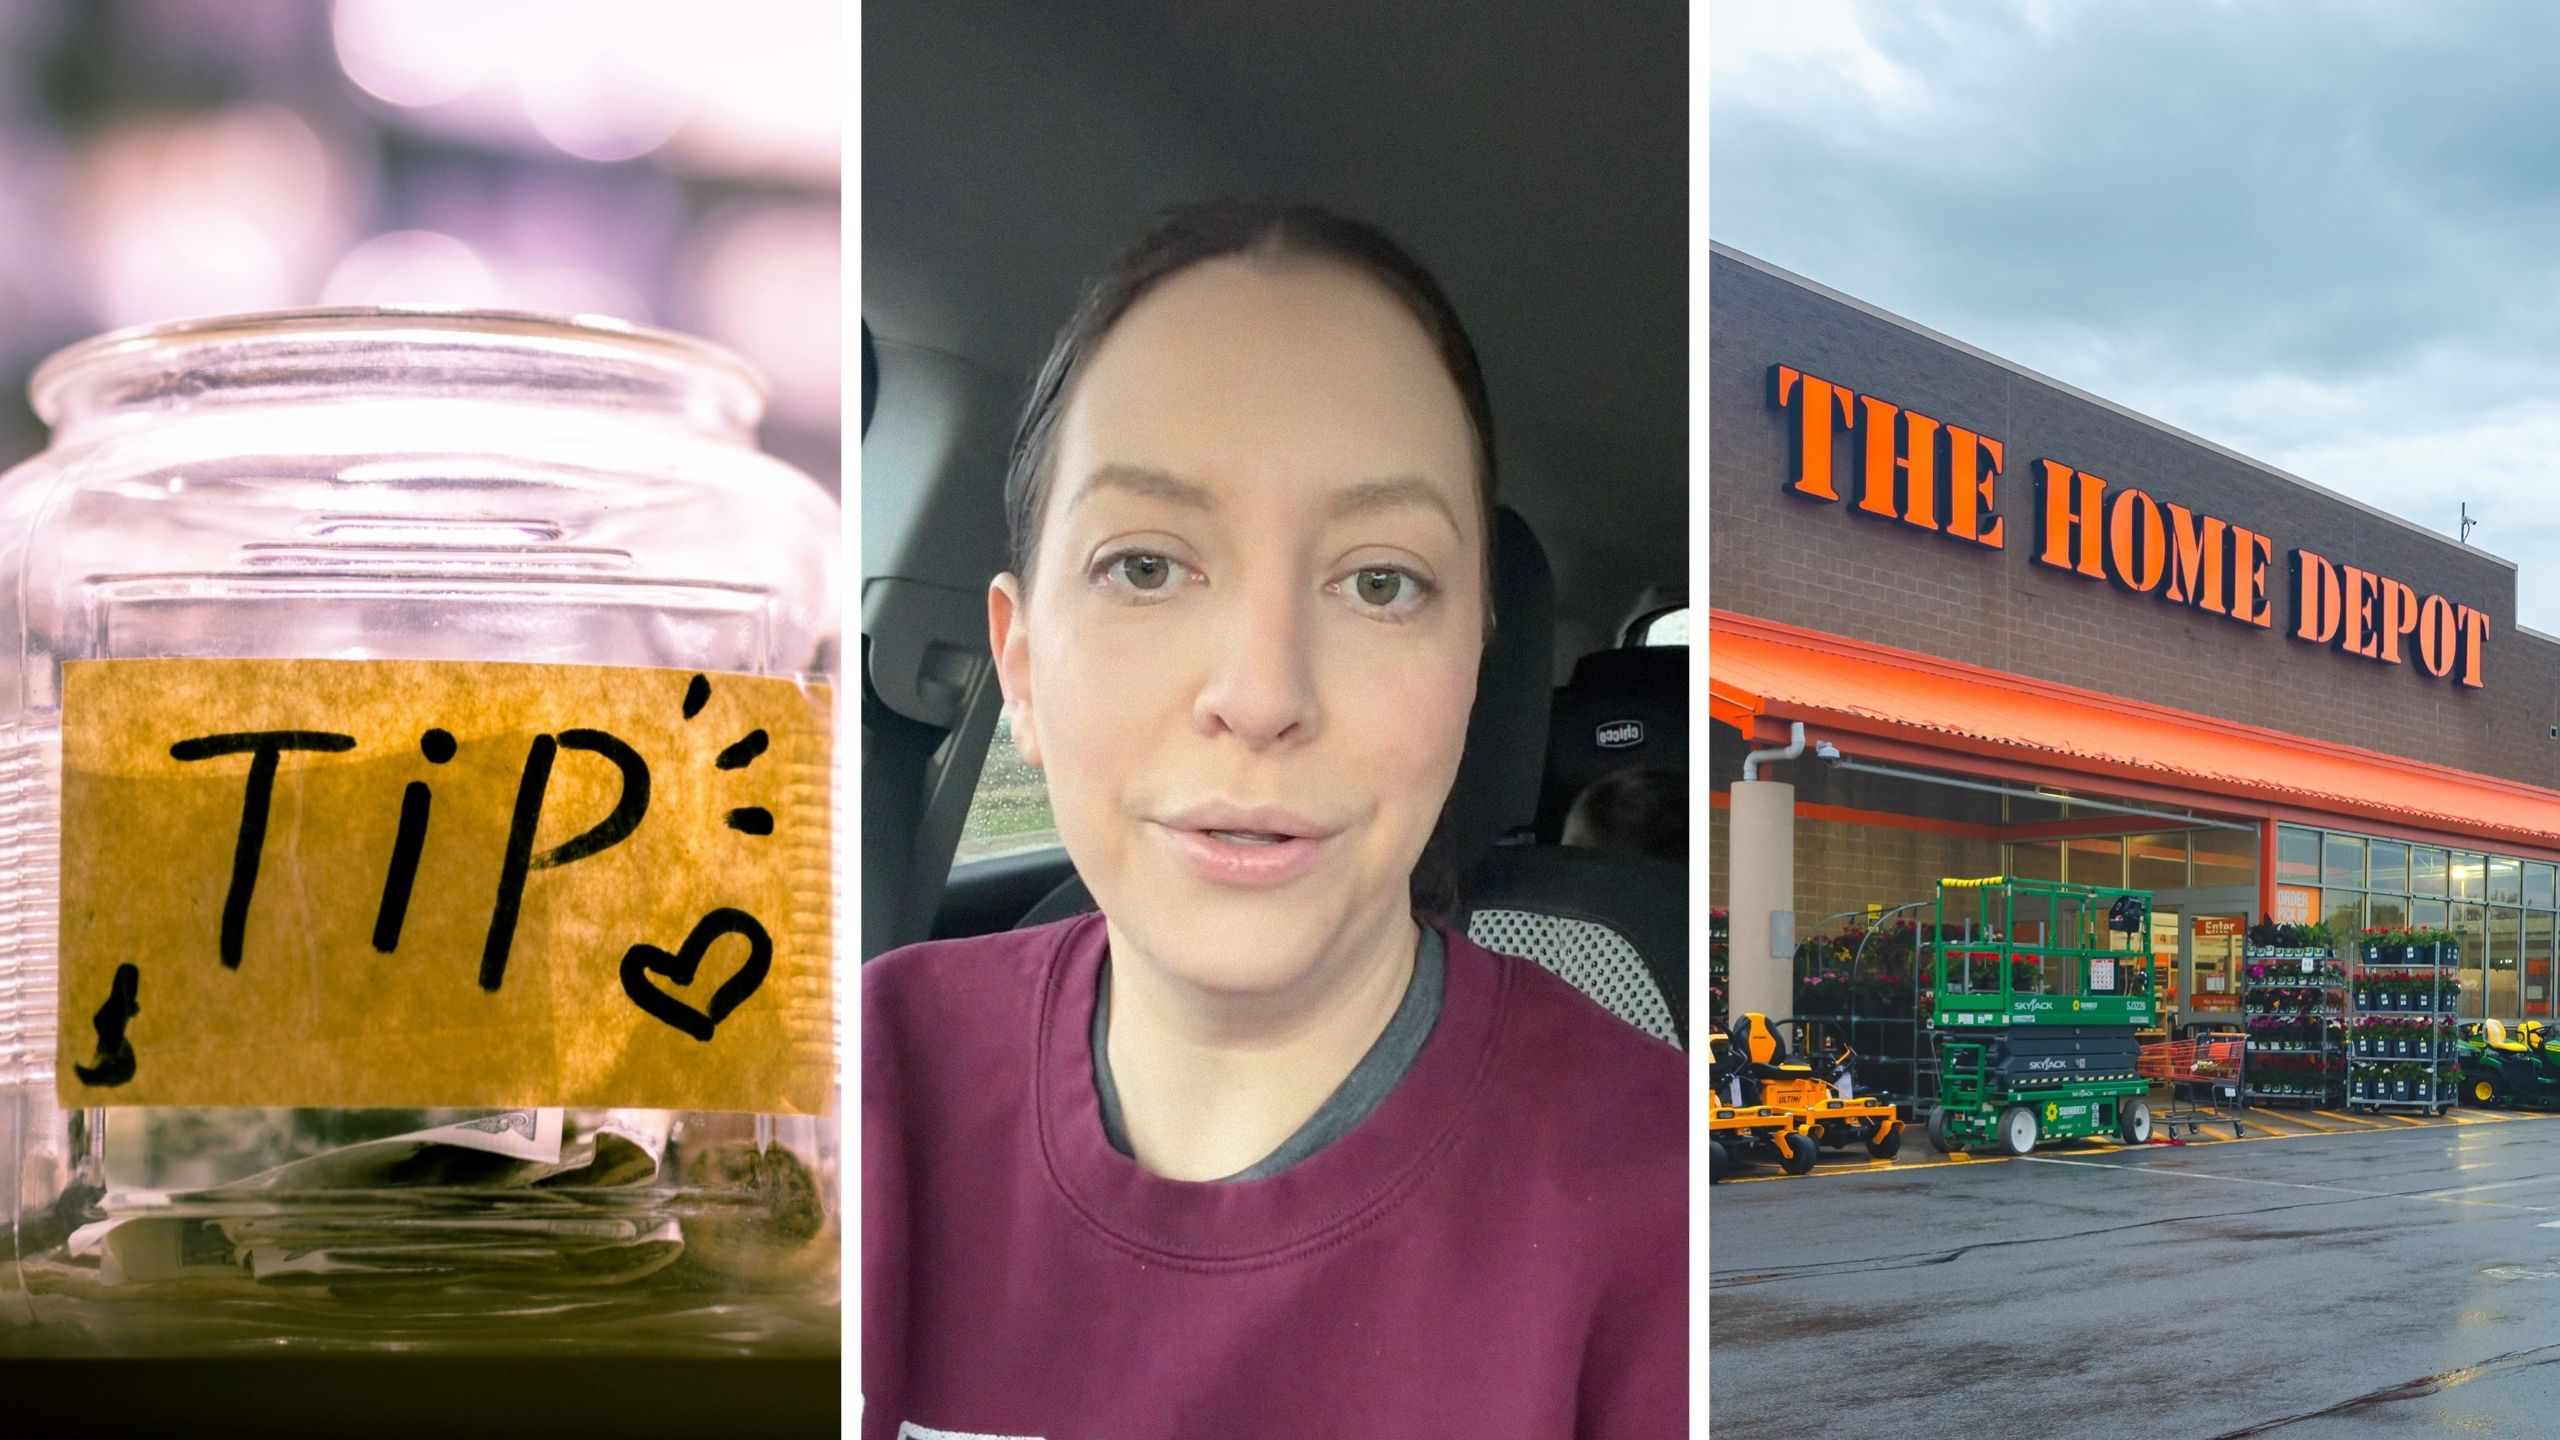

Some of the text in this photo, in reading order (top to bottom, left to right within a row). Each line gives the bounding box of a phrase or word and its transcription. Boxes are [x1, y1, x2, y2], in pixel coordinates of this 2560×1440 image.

[1768, 364, 2491, 689] THE HOME DEPOT
[2278, 891, 2308, 906] ORDER
[2278, 907, 2308, 921] PICK UP
[2205, 920, 2235, 934] Enter
[2015, 999, 2053, 1011] SKYJACK
[2029, 1057, 2066, 1070] SKYJACK
